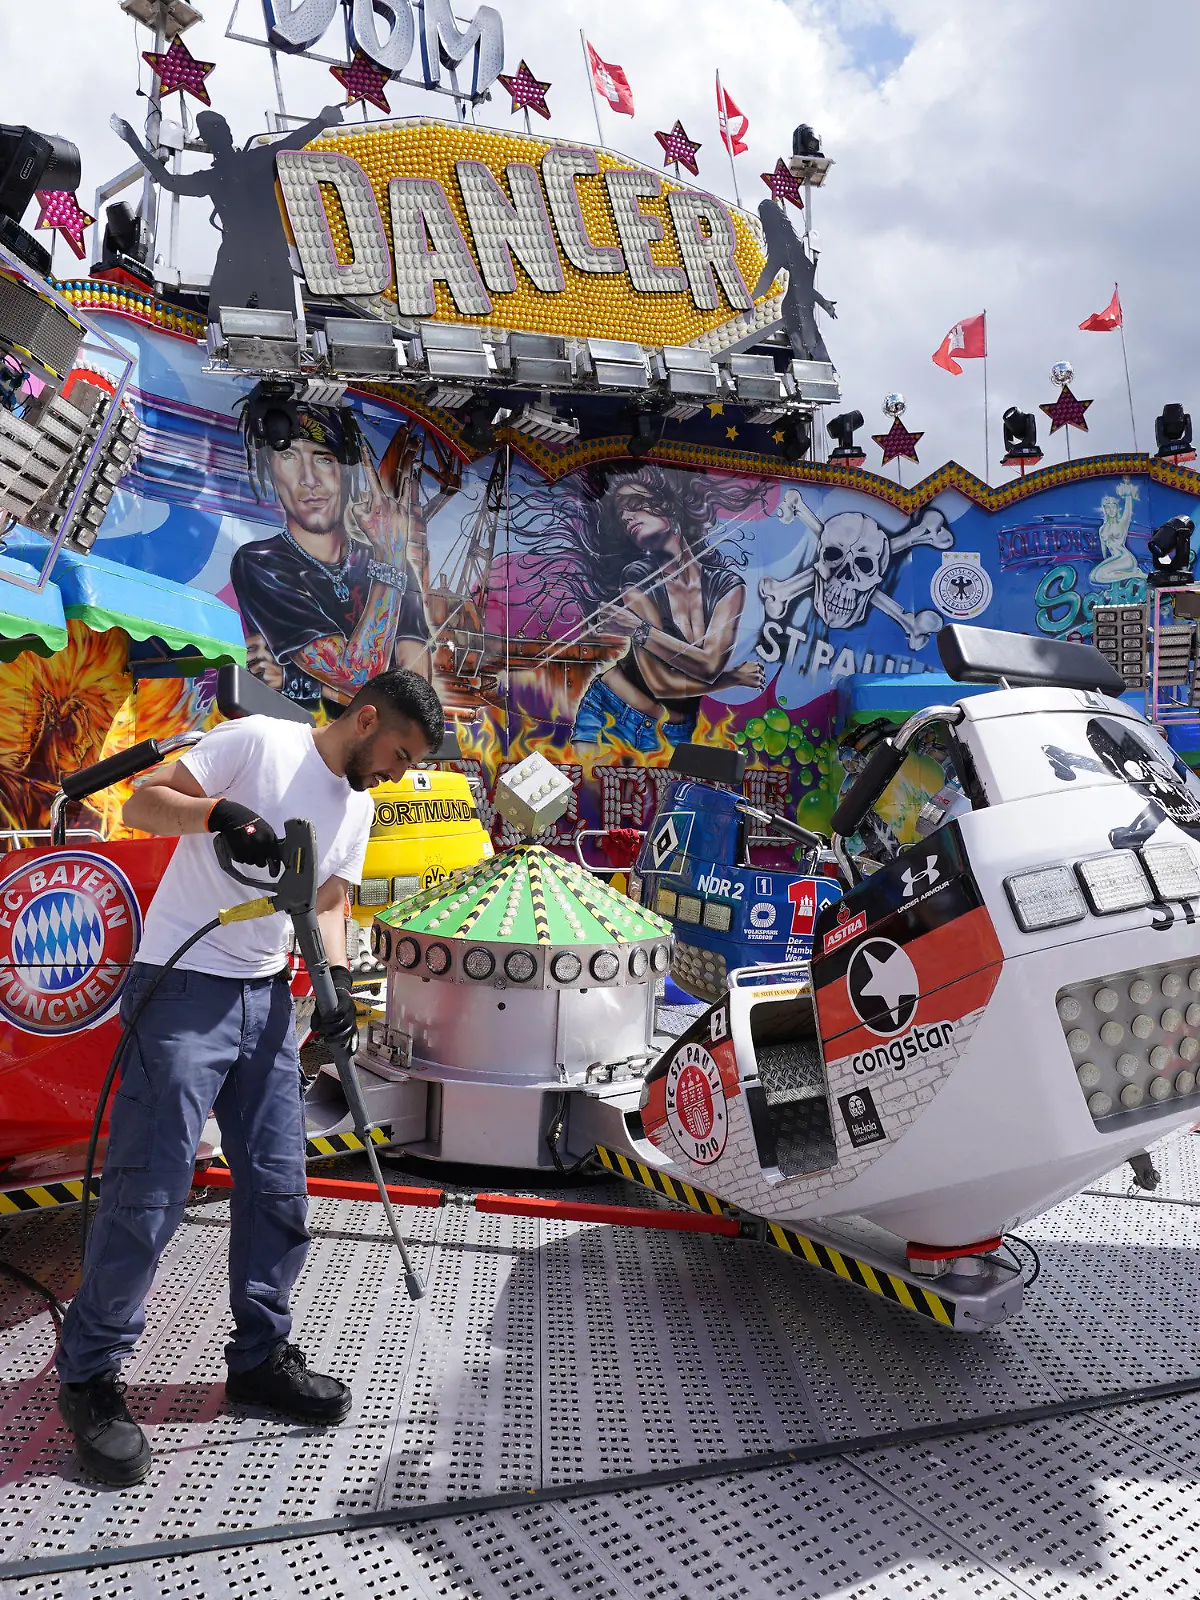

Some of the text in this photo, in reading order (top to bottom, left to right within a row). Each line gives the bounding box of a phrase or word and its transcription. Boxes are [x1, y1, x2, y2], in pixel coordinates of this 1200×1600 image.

[275, 147, 755, 316] DANCER
[28, 864, 128, 930] BAYERN
[697, 875, 745, 900] NDR 2
[760, 878, 767, 894] 1
[897, 880, 950, 914] UNDER ARMOUR
[743, 928, 778, 936] VOLKSPARK
[787, 937, 803, 945] Der
[827, 918, 863, 947] ASTRA
[715, 1012, 722, 1037] 2
[852, 1023, 954, 1075] congstar
[667, 1047, 720, 1108] FC ST. PAULI
[694, 1136, 719, 1159] 1910
